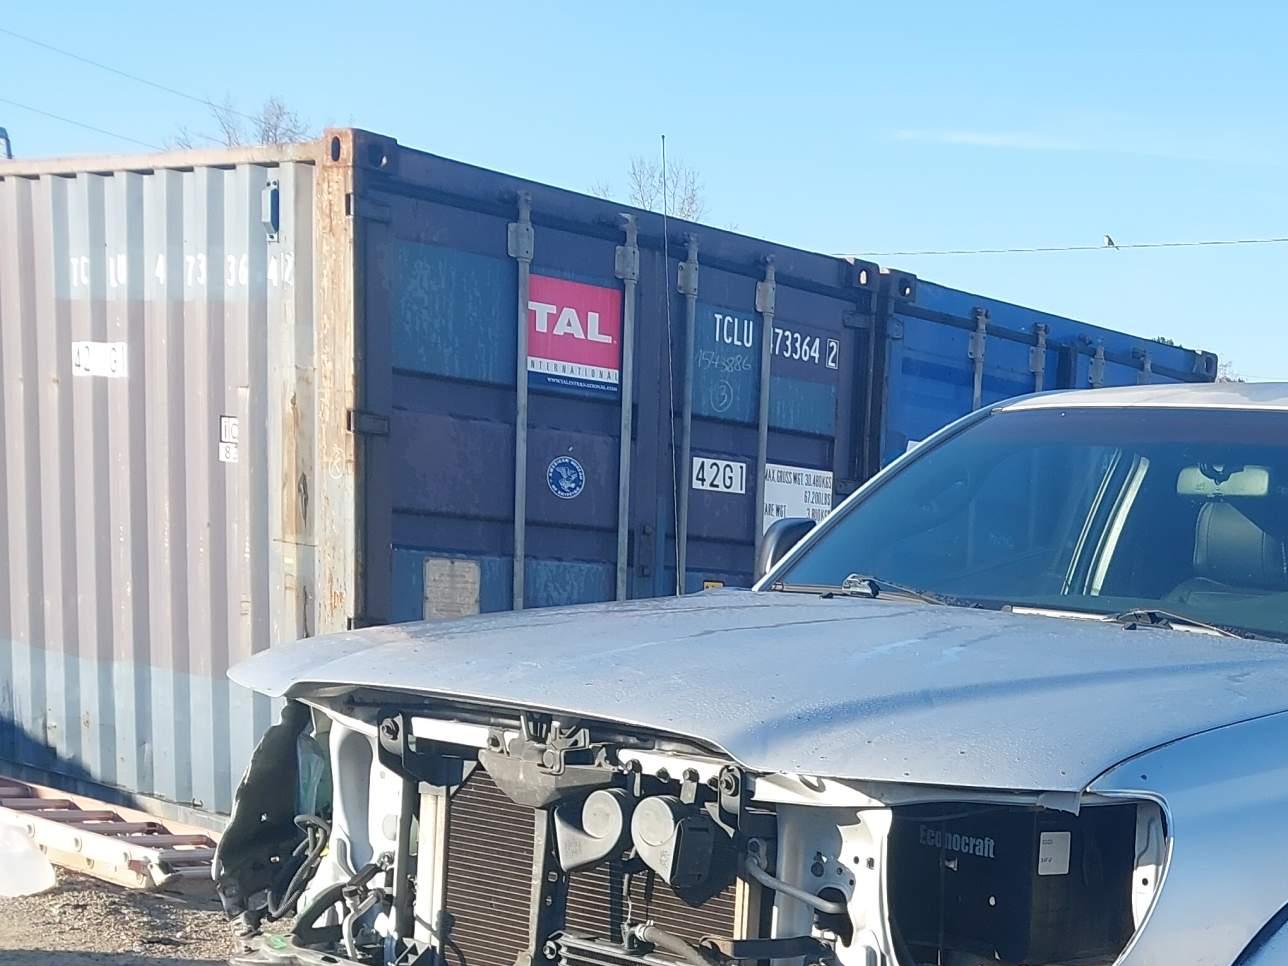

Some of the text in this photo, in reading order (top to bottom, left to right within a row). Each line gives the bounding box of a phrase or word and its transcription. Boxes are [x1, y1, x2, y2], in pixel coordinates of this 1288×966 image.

[528, 301, 612, 343] TAL
[714, 314, 753, 347] TCLU
[771, 327, 820, 364] 73364
[695, 460, 744, 491] 42G1
[919, 824, 995, 858] Econocraft
